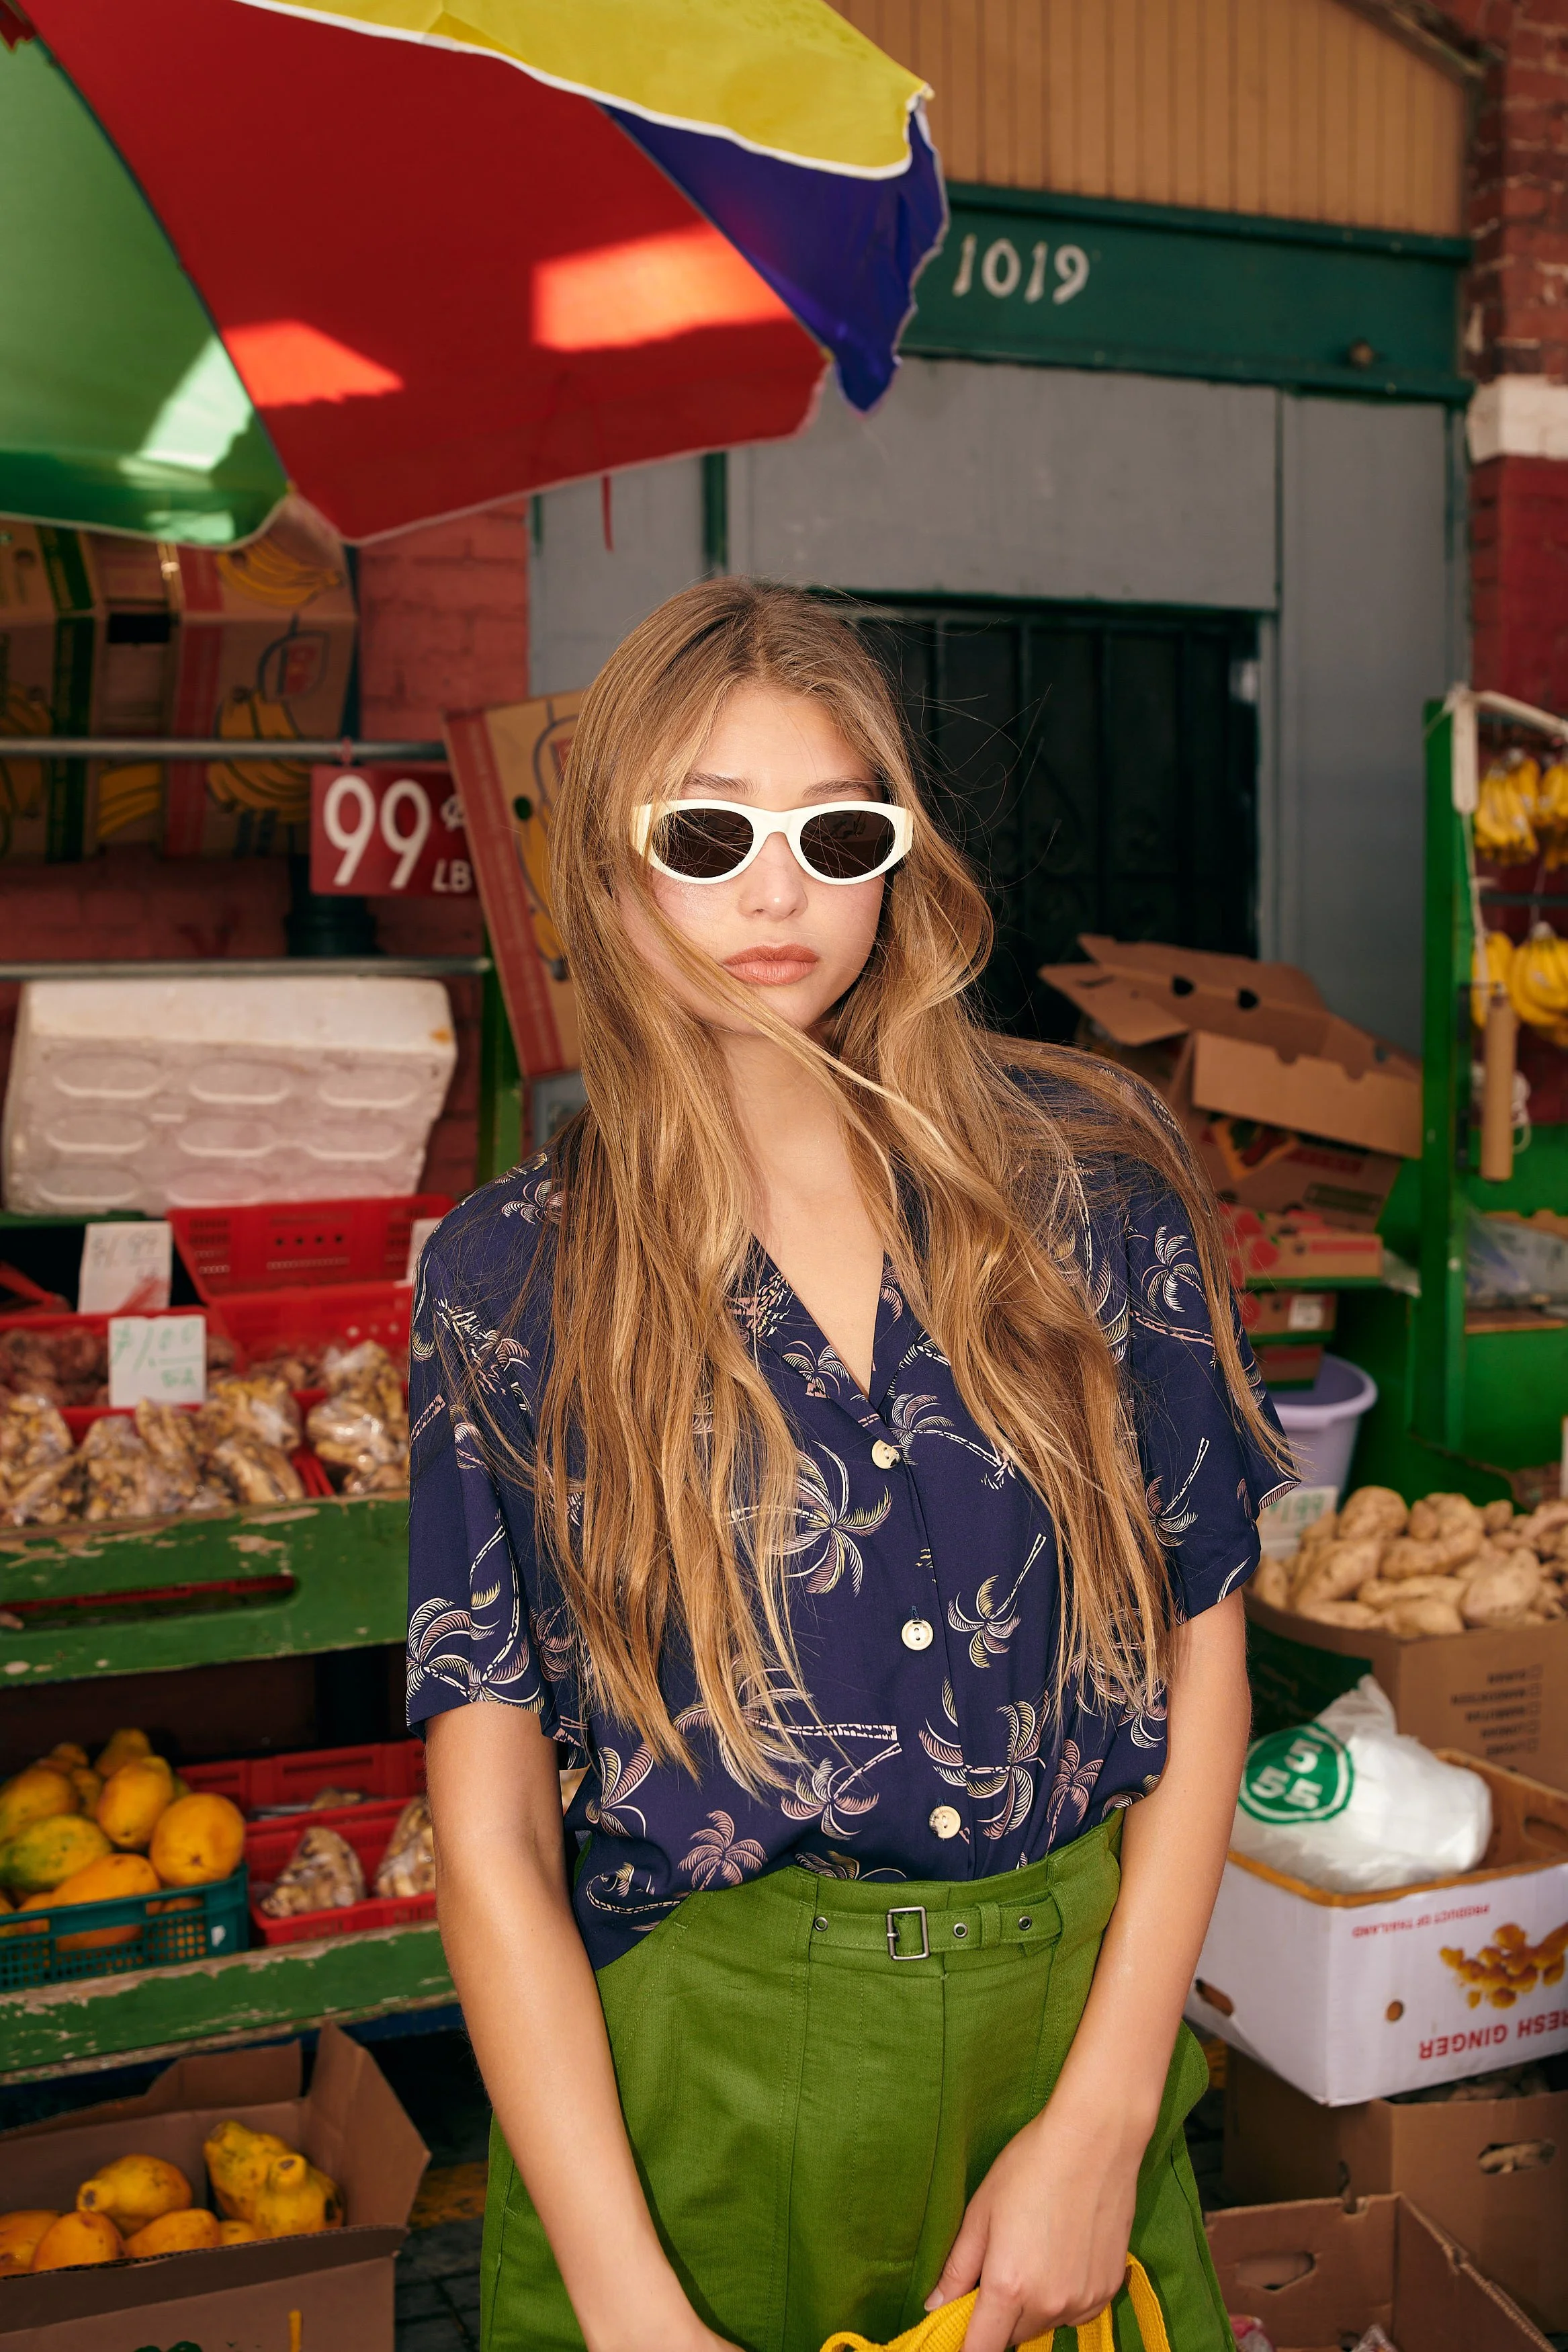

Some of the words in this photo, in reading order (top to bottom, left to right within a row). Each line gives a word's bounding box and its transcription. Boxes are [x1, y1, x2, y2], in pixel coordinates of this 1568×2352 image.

[952, 233, 1090, 304] 1019
[433, 859, 472, 892] LB
[1351, 1919, 1413, 1939] THAILAND
[1415, 1913, 1432, 1929] OF
[1433, 1904, 1491, 1923] PRODUCT
[1517, 2007, 1568, 2040] RESH
[1419, 2023, 1510, 2060] GINGER
